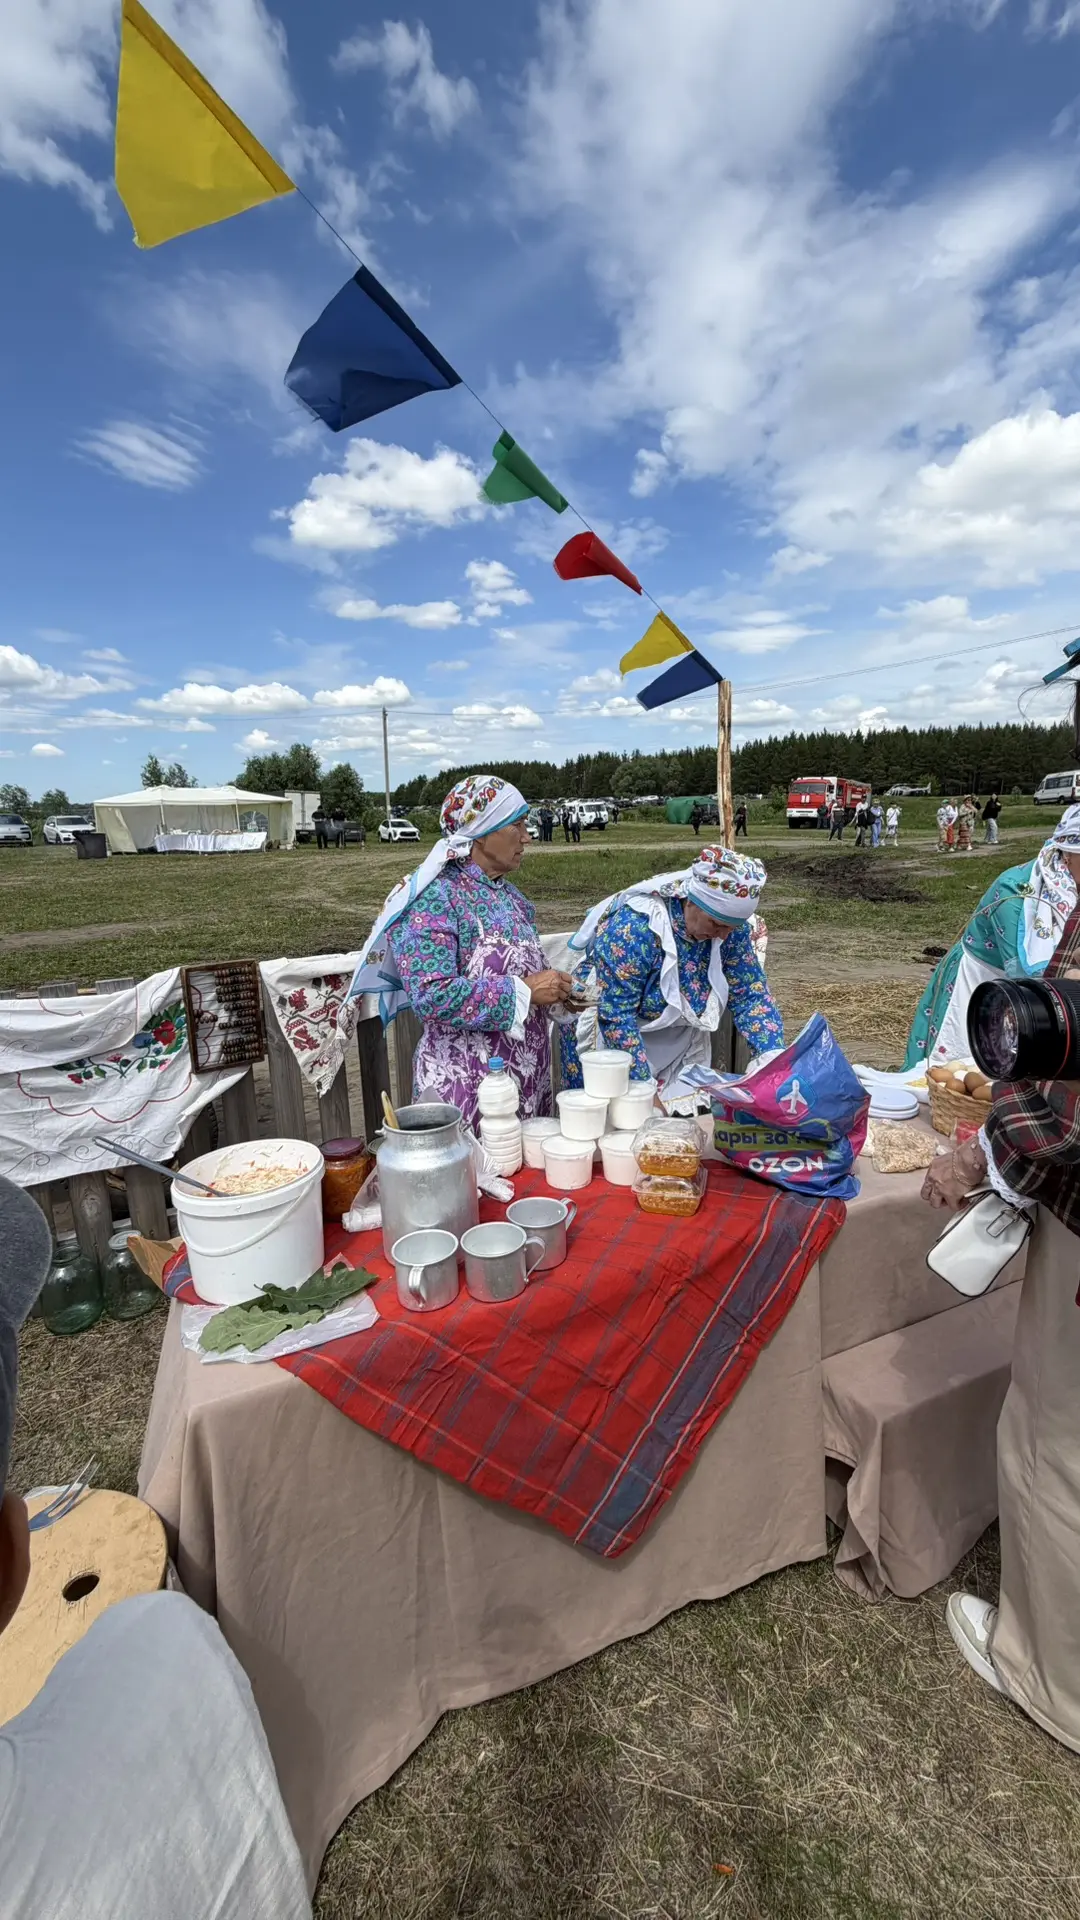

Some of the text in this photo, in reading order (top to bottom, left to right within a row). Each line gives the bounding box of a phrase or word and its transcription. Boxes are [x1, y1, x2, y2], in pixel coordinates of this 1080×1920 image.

[715, 1130, 758, 1148] ары
[763, 1132, 789, 1145] за
[748, 1156, 824, 1173] OZON
